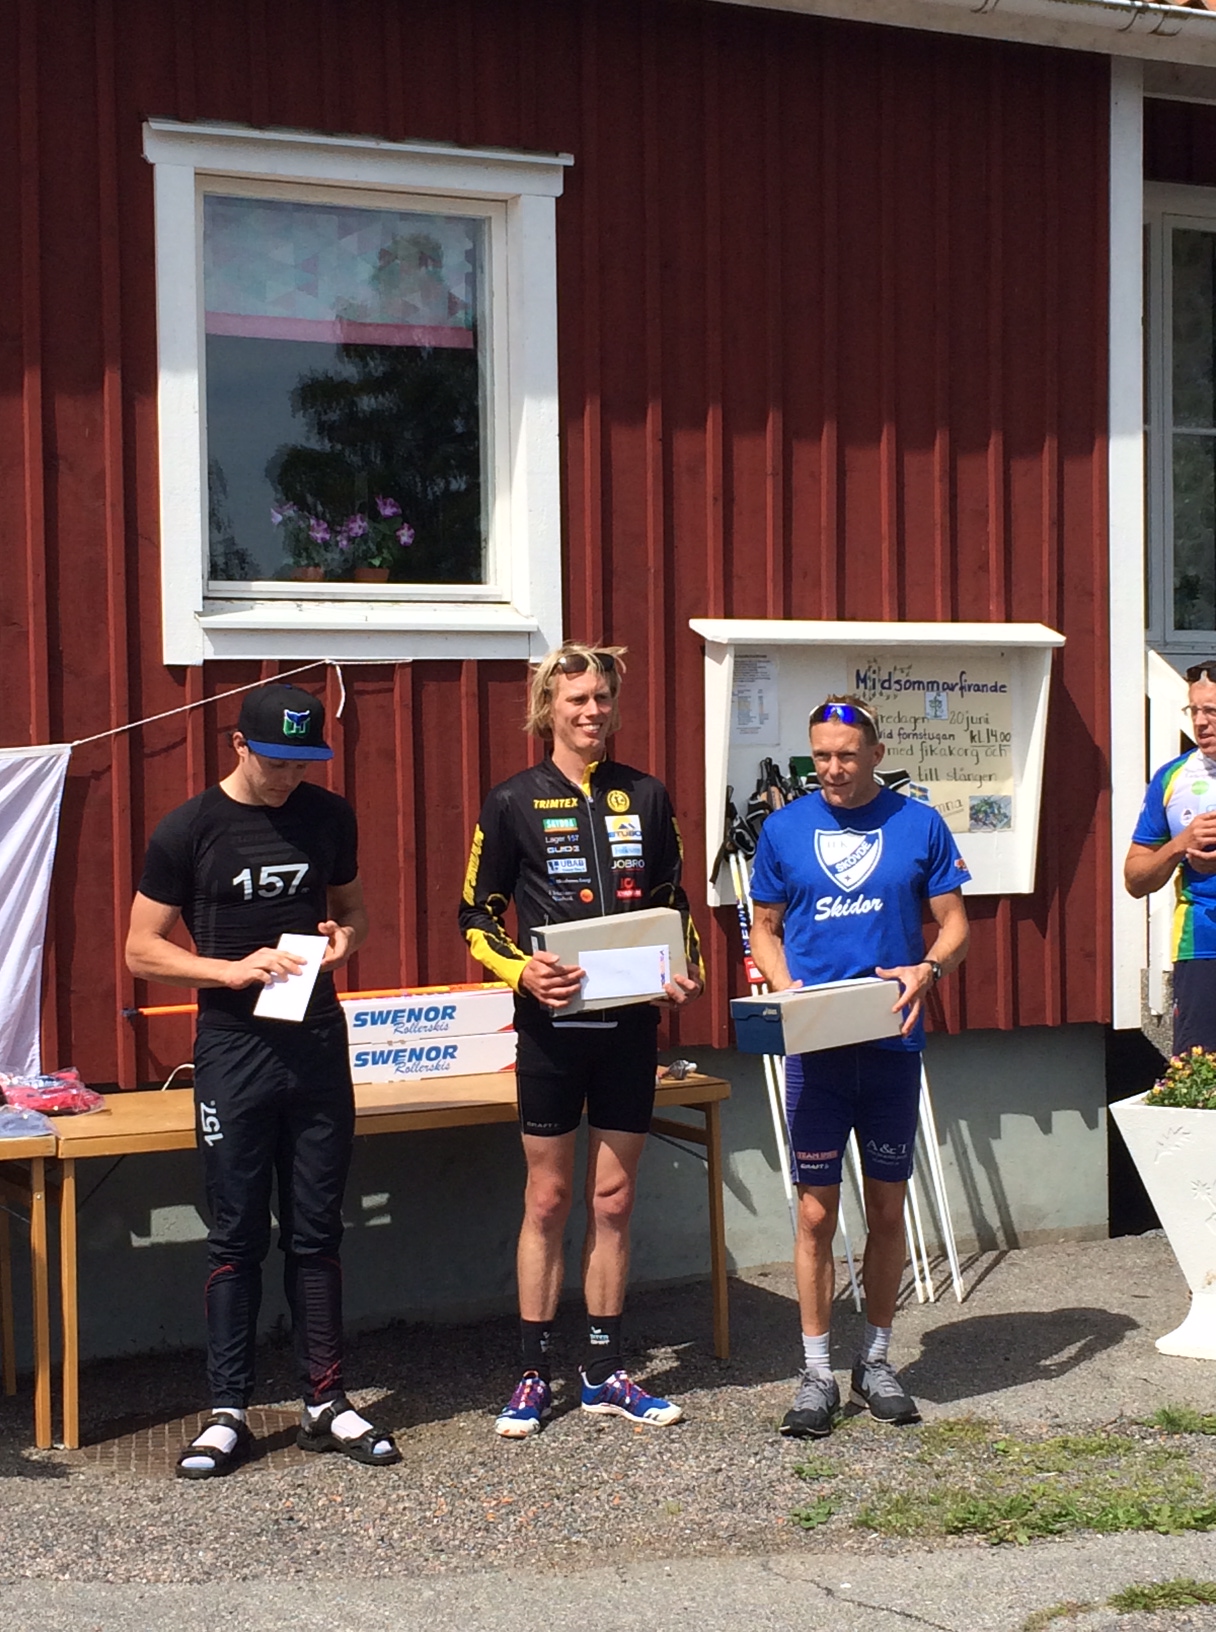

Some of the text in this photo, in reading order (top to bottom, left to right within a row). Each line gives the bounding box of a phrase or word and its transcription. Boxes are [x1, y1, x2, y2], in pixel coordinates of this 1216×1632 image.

[855, 669, 1007, 698] Midsommarfirande
[879, 711, 990, 732] redagen 20 juni
[887, 741, 1007, 765] med fikakorg och
[918, 765, 939, 782] till
[533, 797, 578, 810] TRIMTEX
[545, 835, 566, 844] Lager
[611, 859, 645, 870] JOBRO
[814, 894, 883, 921] Skidor
[353, 1005, 457, 1028] SWENOR
[393, 1021, 449, 1035] Rollerskis
[354, 1044, 458, 1068] SWENOR
[394, 1059, 450, 1074] Rollerskis
